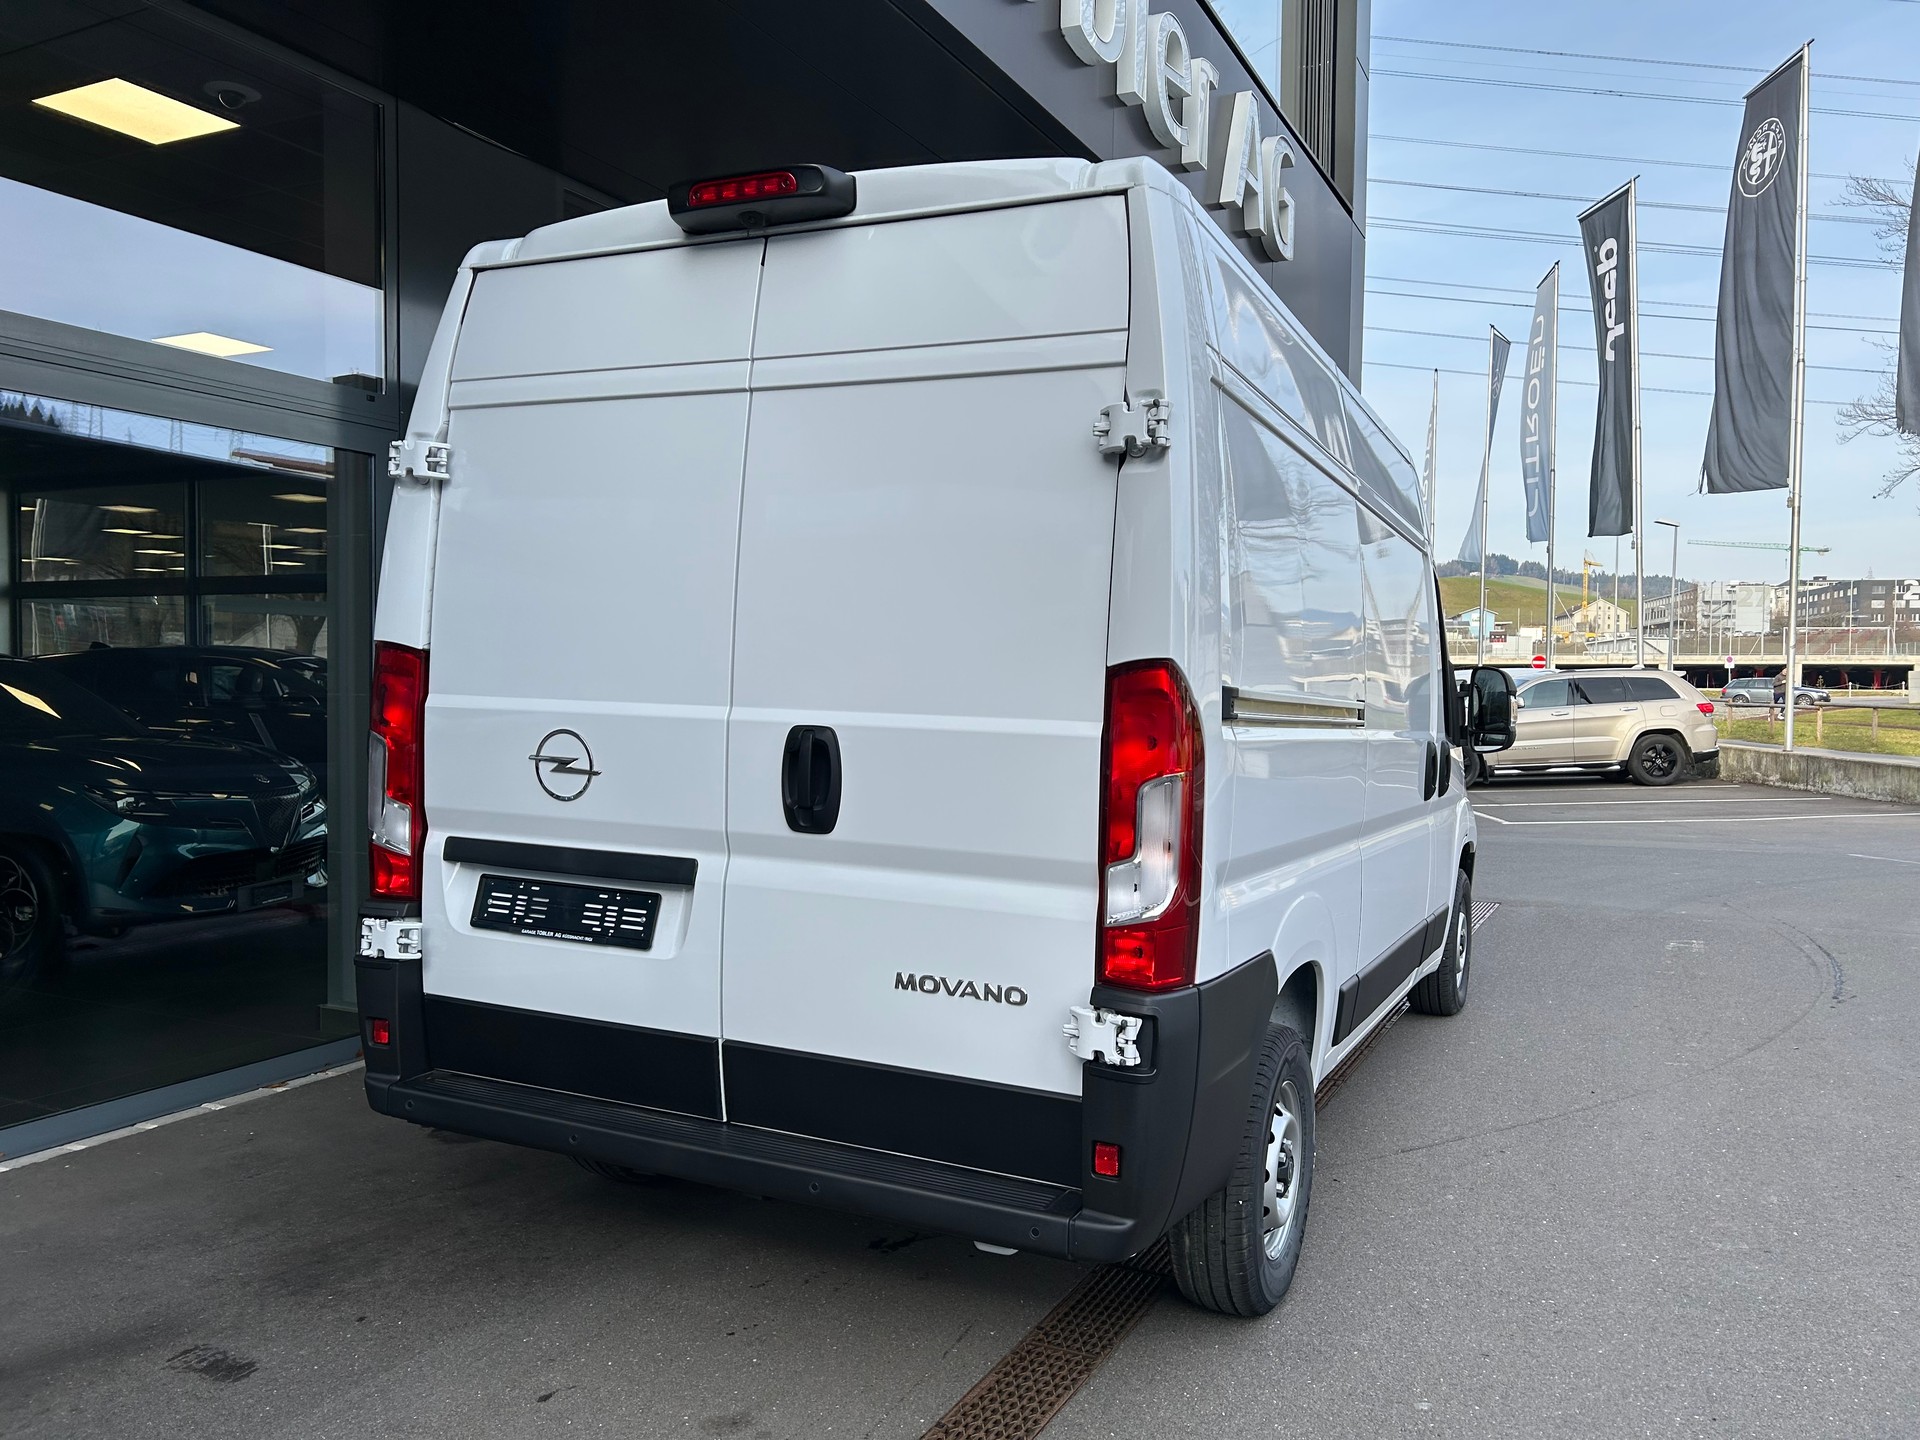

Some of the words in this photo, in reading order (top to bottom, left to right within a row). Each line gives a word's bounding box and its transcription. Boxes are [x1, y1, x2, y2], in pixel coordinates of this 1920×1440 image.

[1219, 90, 1296, 262] AG
[1738, 587, 1770, 607] 27
[537, 929, 554, 937] TOBLER
[894, 971, 1028, 1006] MOVANO
